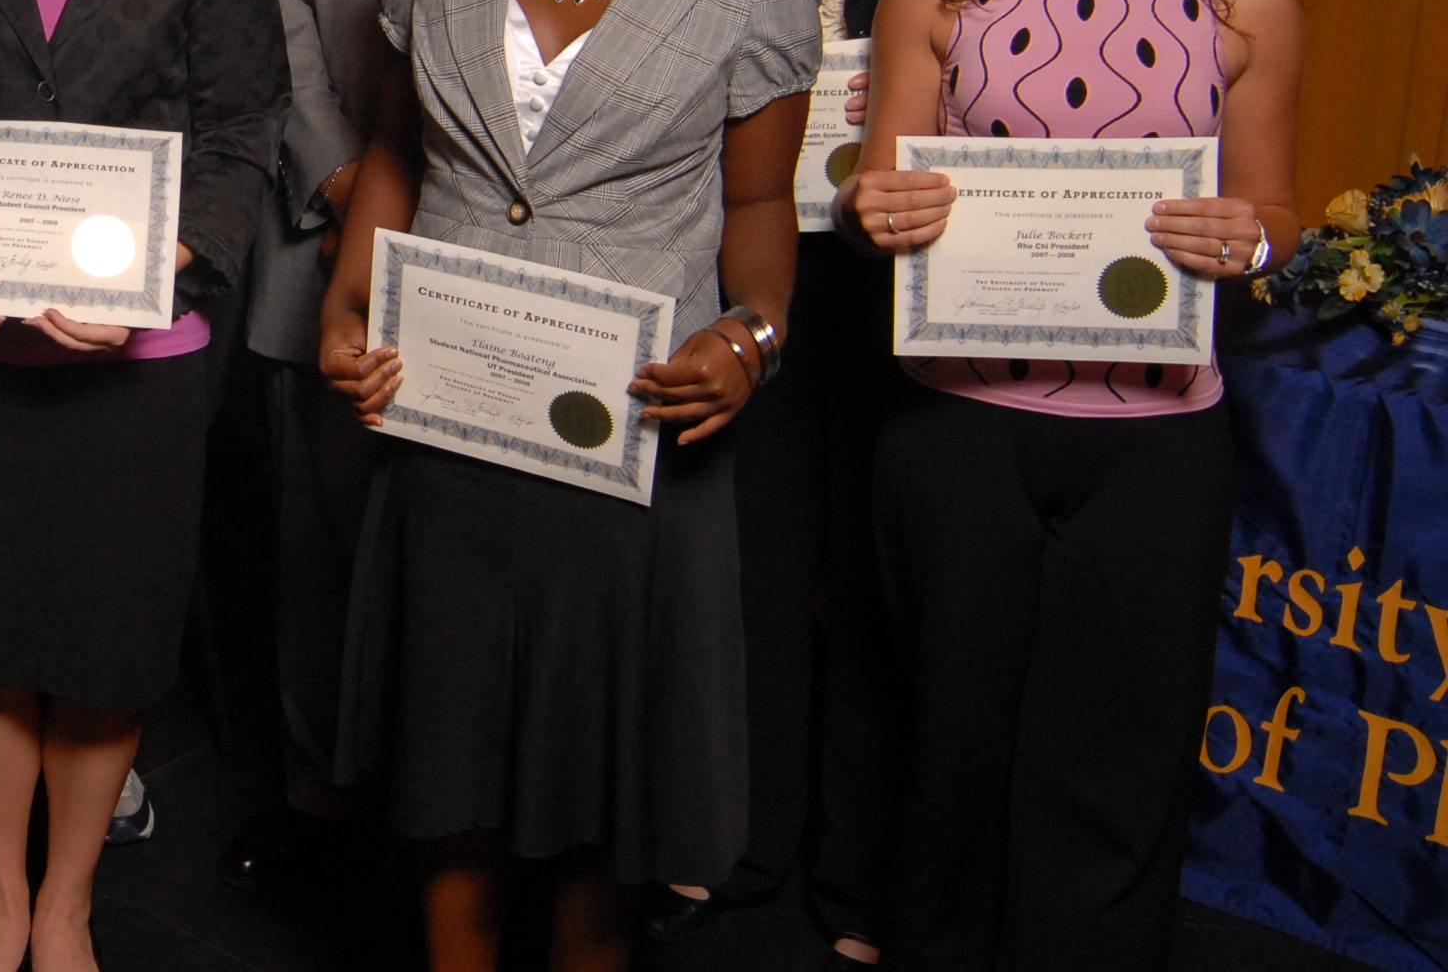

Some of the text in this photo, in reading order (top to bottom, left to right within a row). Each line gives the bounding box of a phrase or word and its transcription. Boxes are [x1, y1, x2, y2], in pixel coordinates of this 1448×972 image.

[32, 159, 47, 168] OF
[51, 160, 136, 173] APPRECIATION
[51, 178, 83, 186] presented
[2, 190, 81, 203] Renee D. Niese
[958, 189, 1164, 200] ERTIFICATE OF APPRECIATION
[24, 203, 50, 211] Council
[51, 205, 86, 213] President
[1064, 212, 1103, 221] presented
[1013, 230, 1094, 241] Julie Bockert
[1017, 242, 1090, 250] Rho Chi President
[418, 286, 620, 342] CERTIFICATE OF APPRECIATION
[476, 322, 513, 337] certificate
[524, 332, 561, 350] presented
[471, 339, 556, 370] Elaine Boateng
[429, 337, 597, 388] Student National Pharmaceutical Association
[487, 362, 498, 370] UT
[498, 365, 534, 381] President
[490, 371, 506, 380] 2007
[1199, 686, 1448, 846] of P
